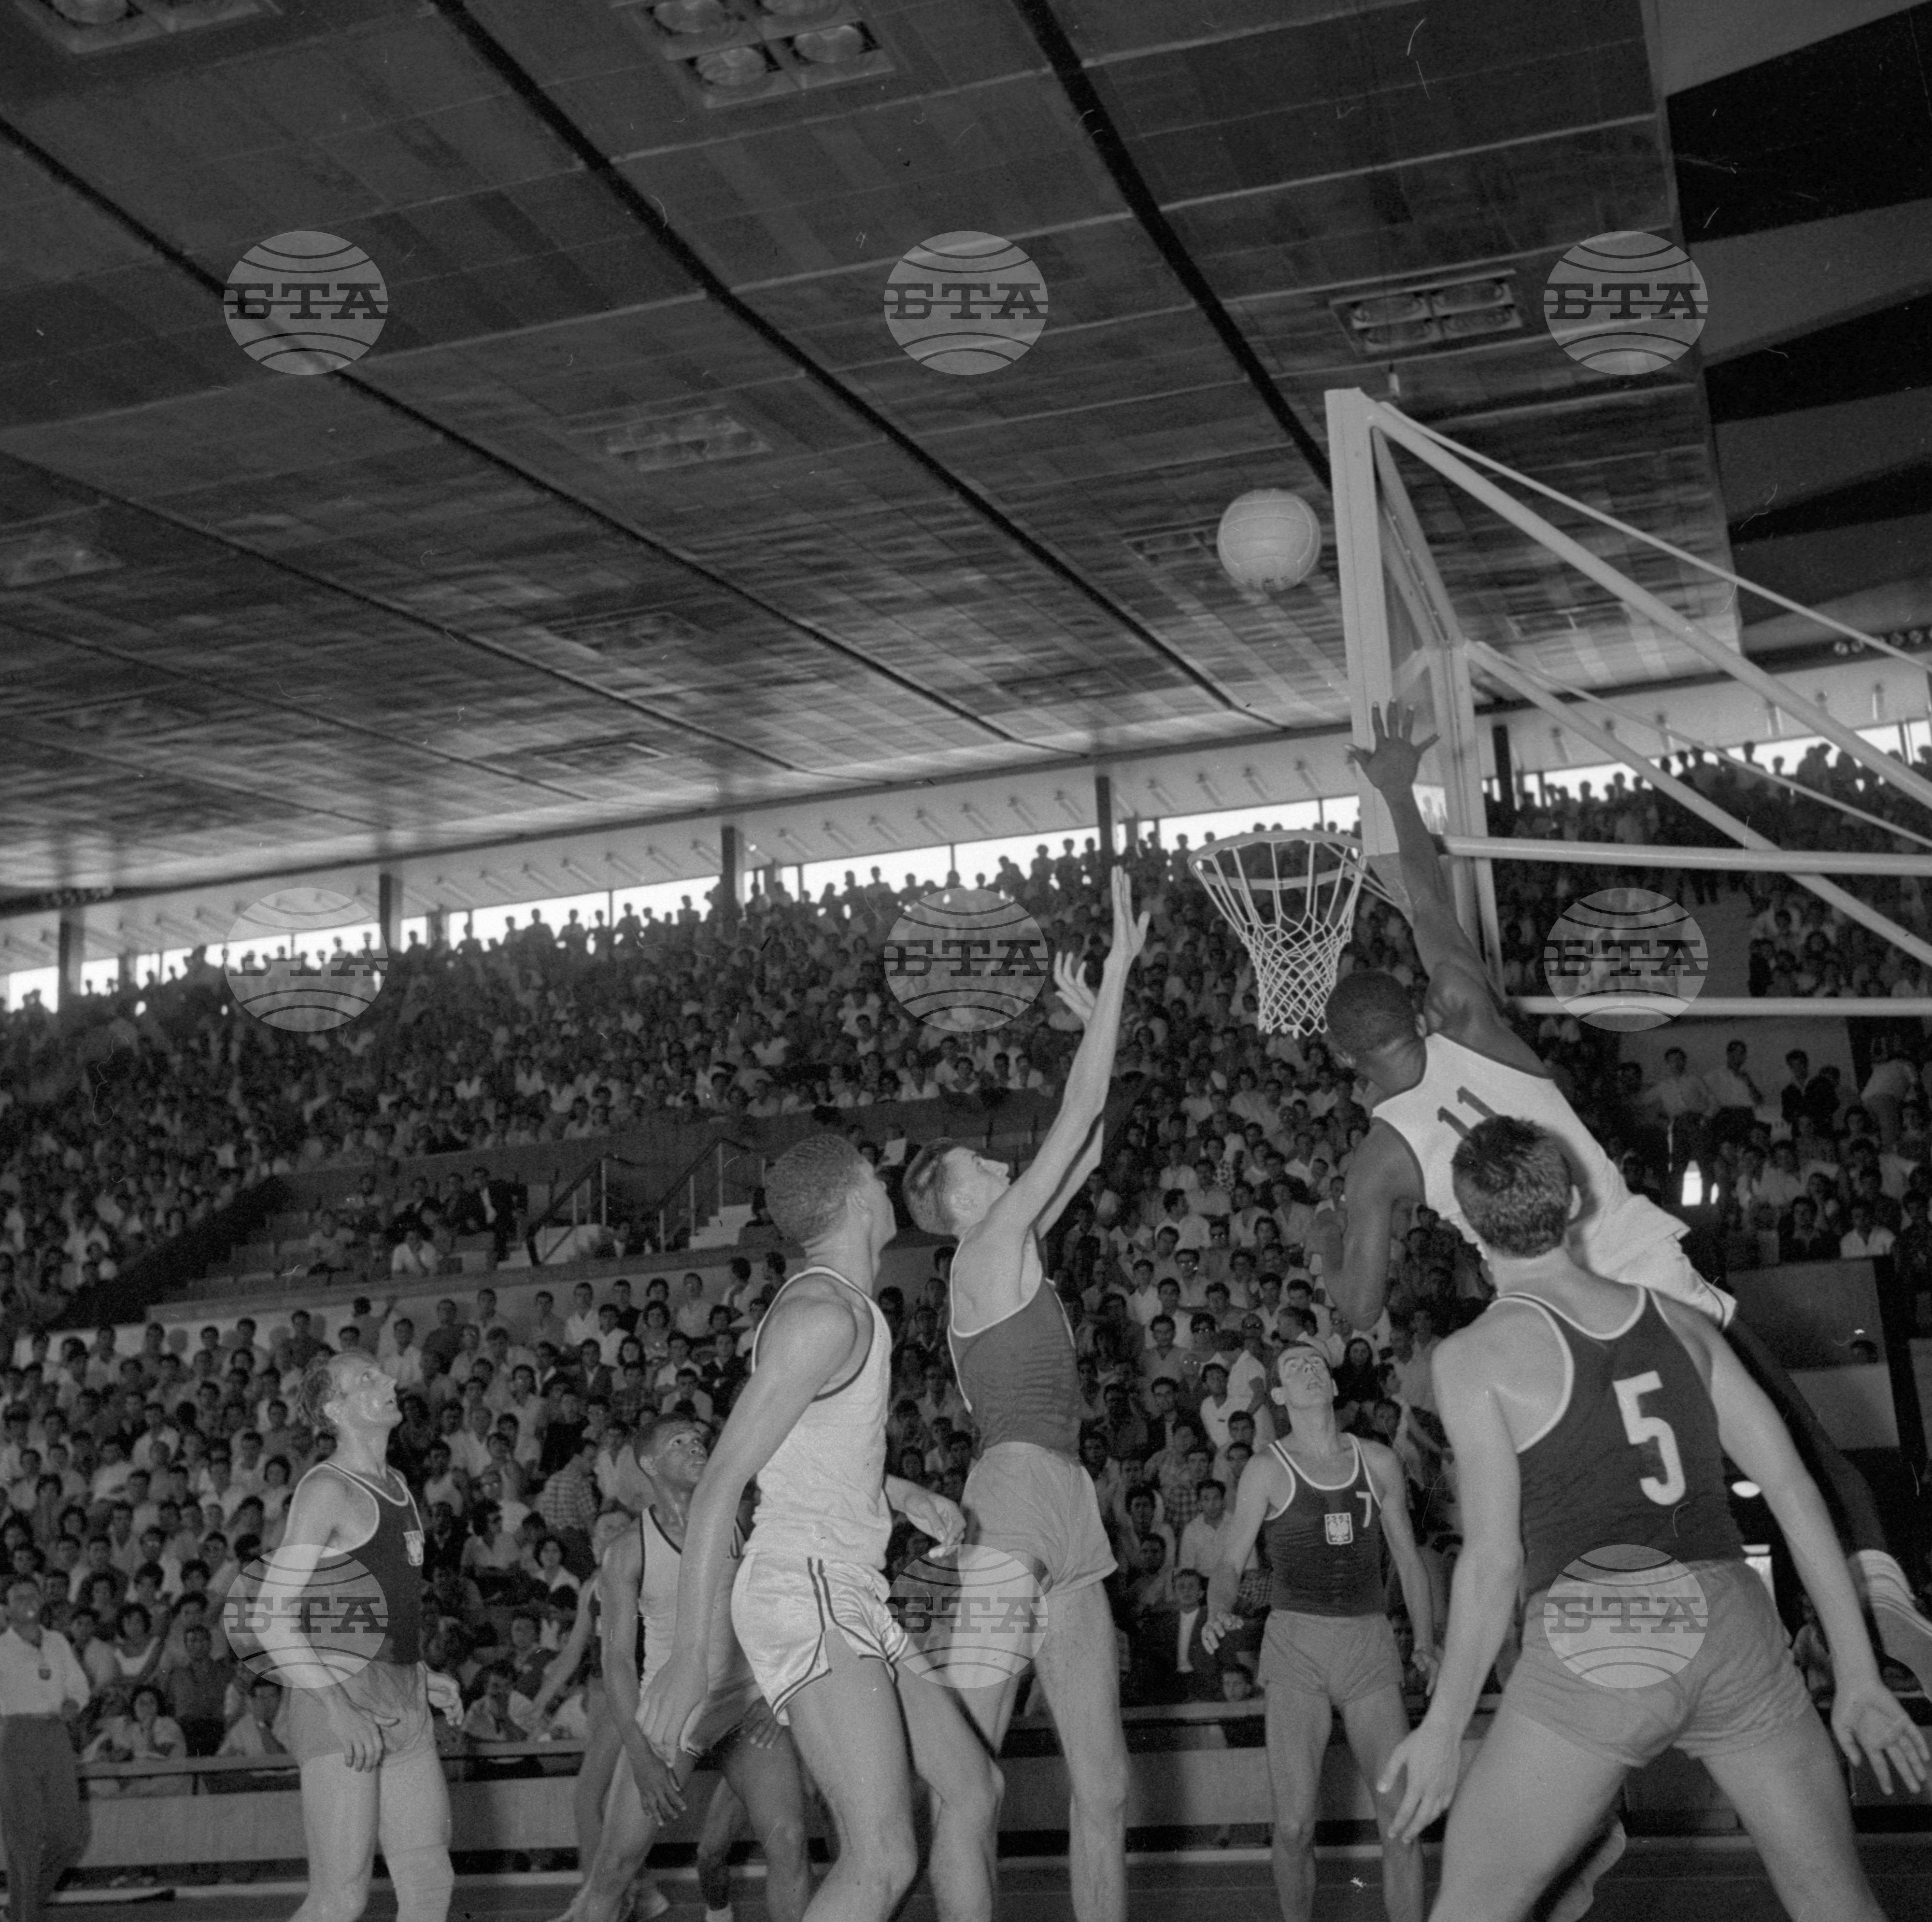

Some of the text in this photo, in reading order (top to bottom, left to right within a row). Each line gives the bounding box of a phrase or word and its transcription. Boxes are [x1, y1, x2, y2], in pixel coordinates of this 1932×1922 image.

[1437, 1086, 1497, 1138] 11
[1613, 1371, 1686, 1505] 5
[1356, 1491, 1372, 1528] 7
